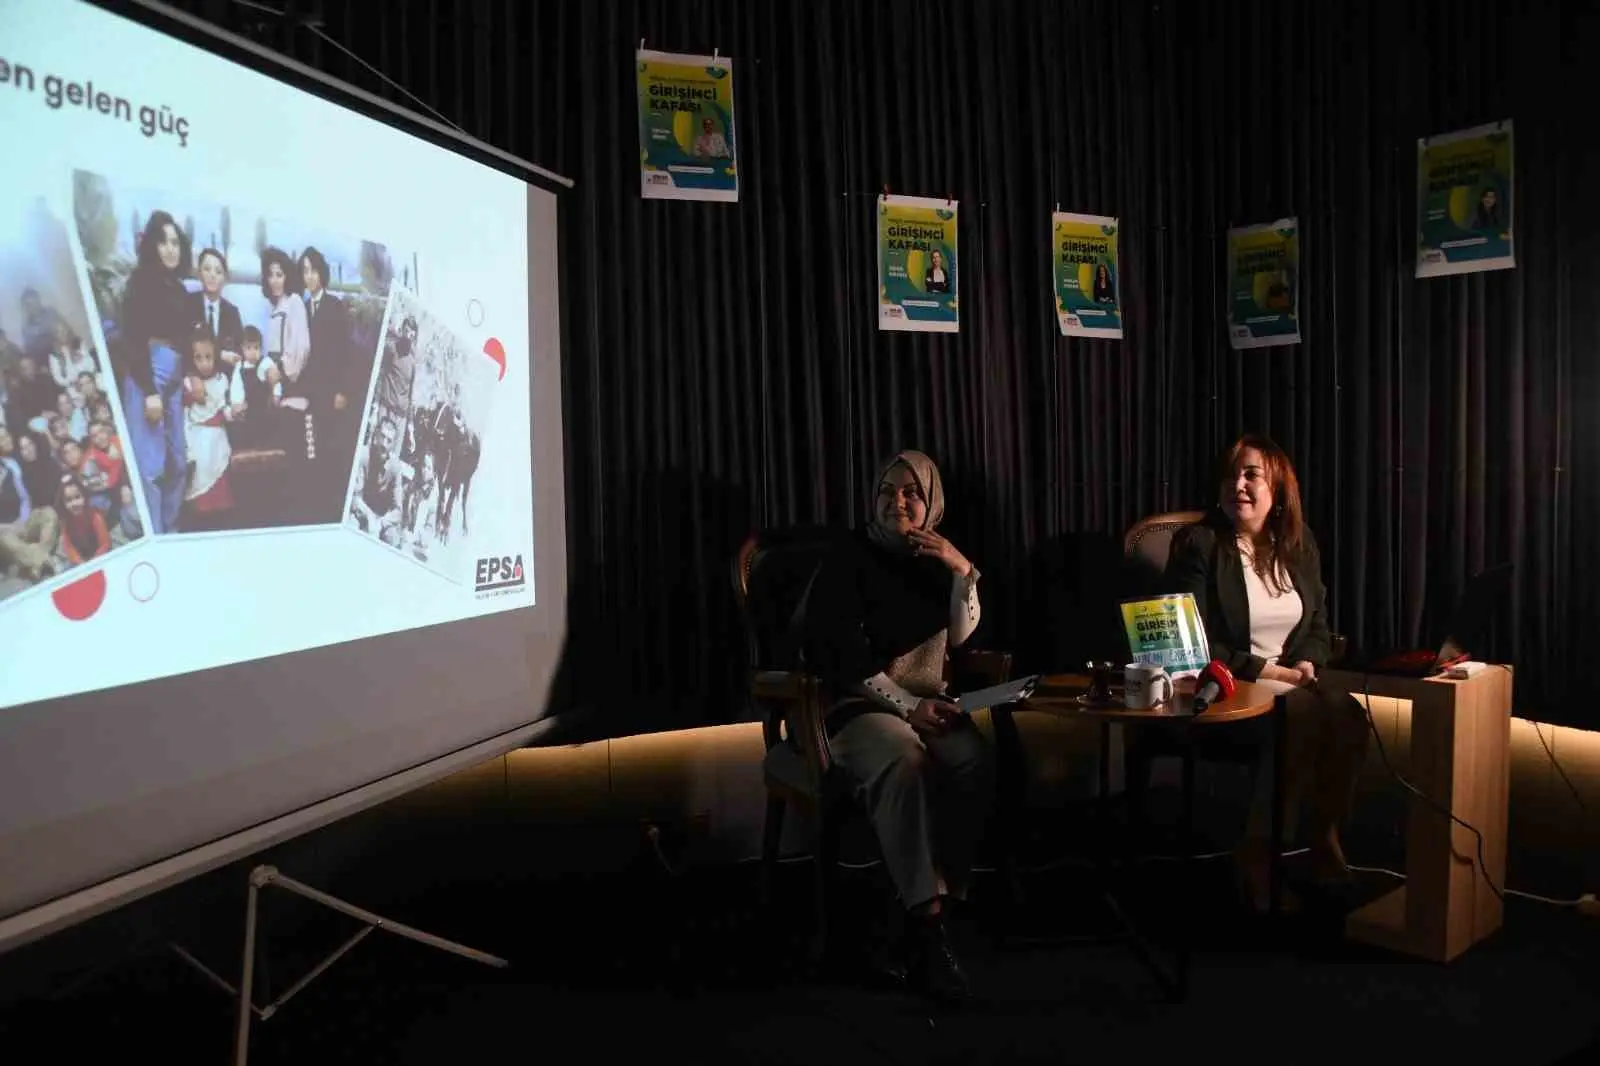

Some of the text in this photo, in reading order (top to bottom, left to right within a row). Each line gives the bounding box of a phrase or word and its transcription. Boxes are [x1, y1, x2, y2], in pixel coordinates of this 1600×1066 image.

[649, 83, 717, 101] GİRİŞİMCİ
[44, 74, 132, 121] gelen
[139, 104, 190, 148] güç
[649, 97, 703, 113] KAFASI
[887, 226, 945, 241] GİRİŞİMCİ
[888, 239, 931, 252] KAFASI
[1061, 240, 1109, 255] GİRİŞİMCİ
[475, 554, 525, 584] EPSA
